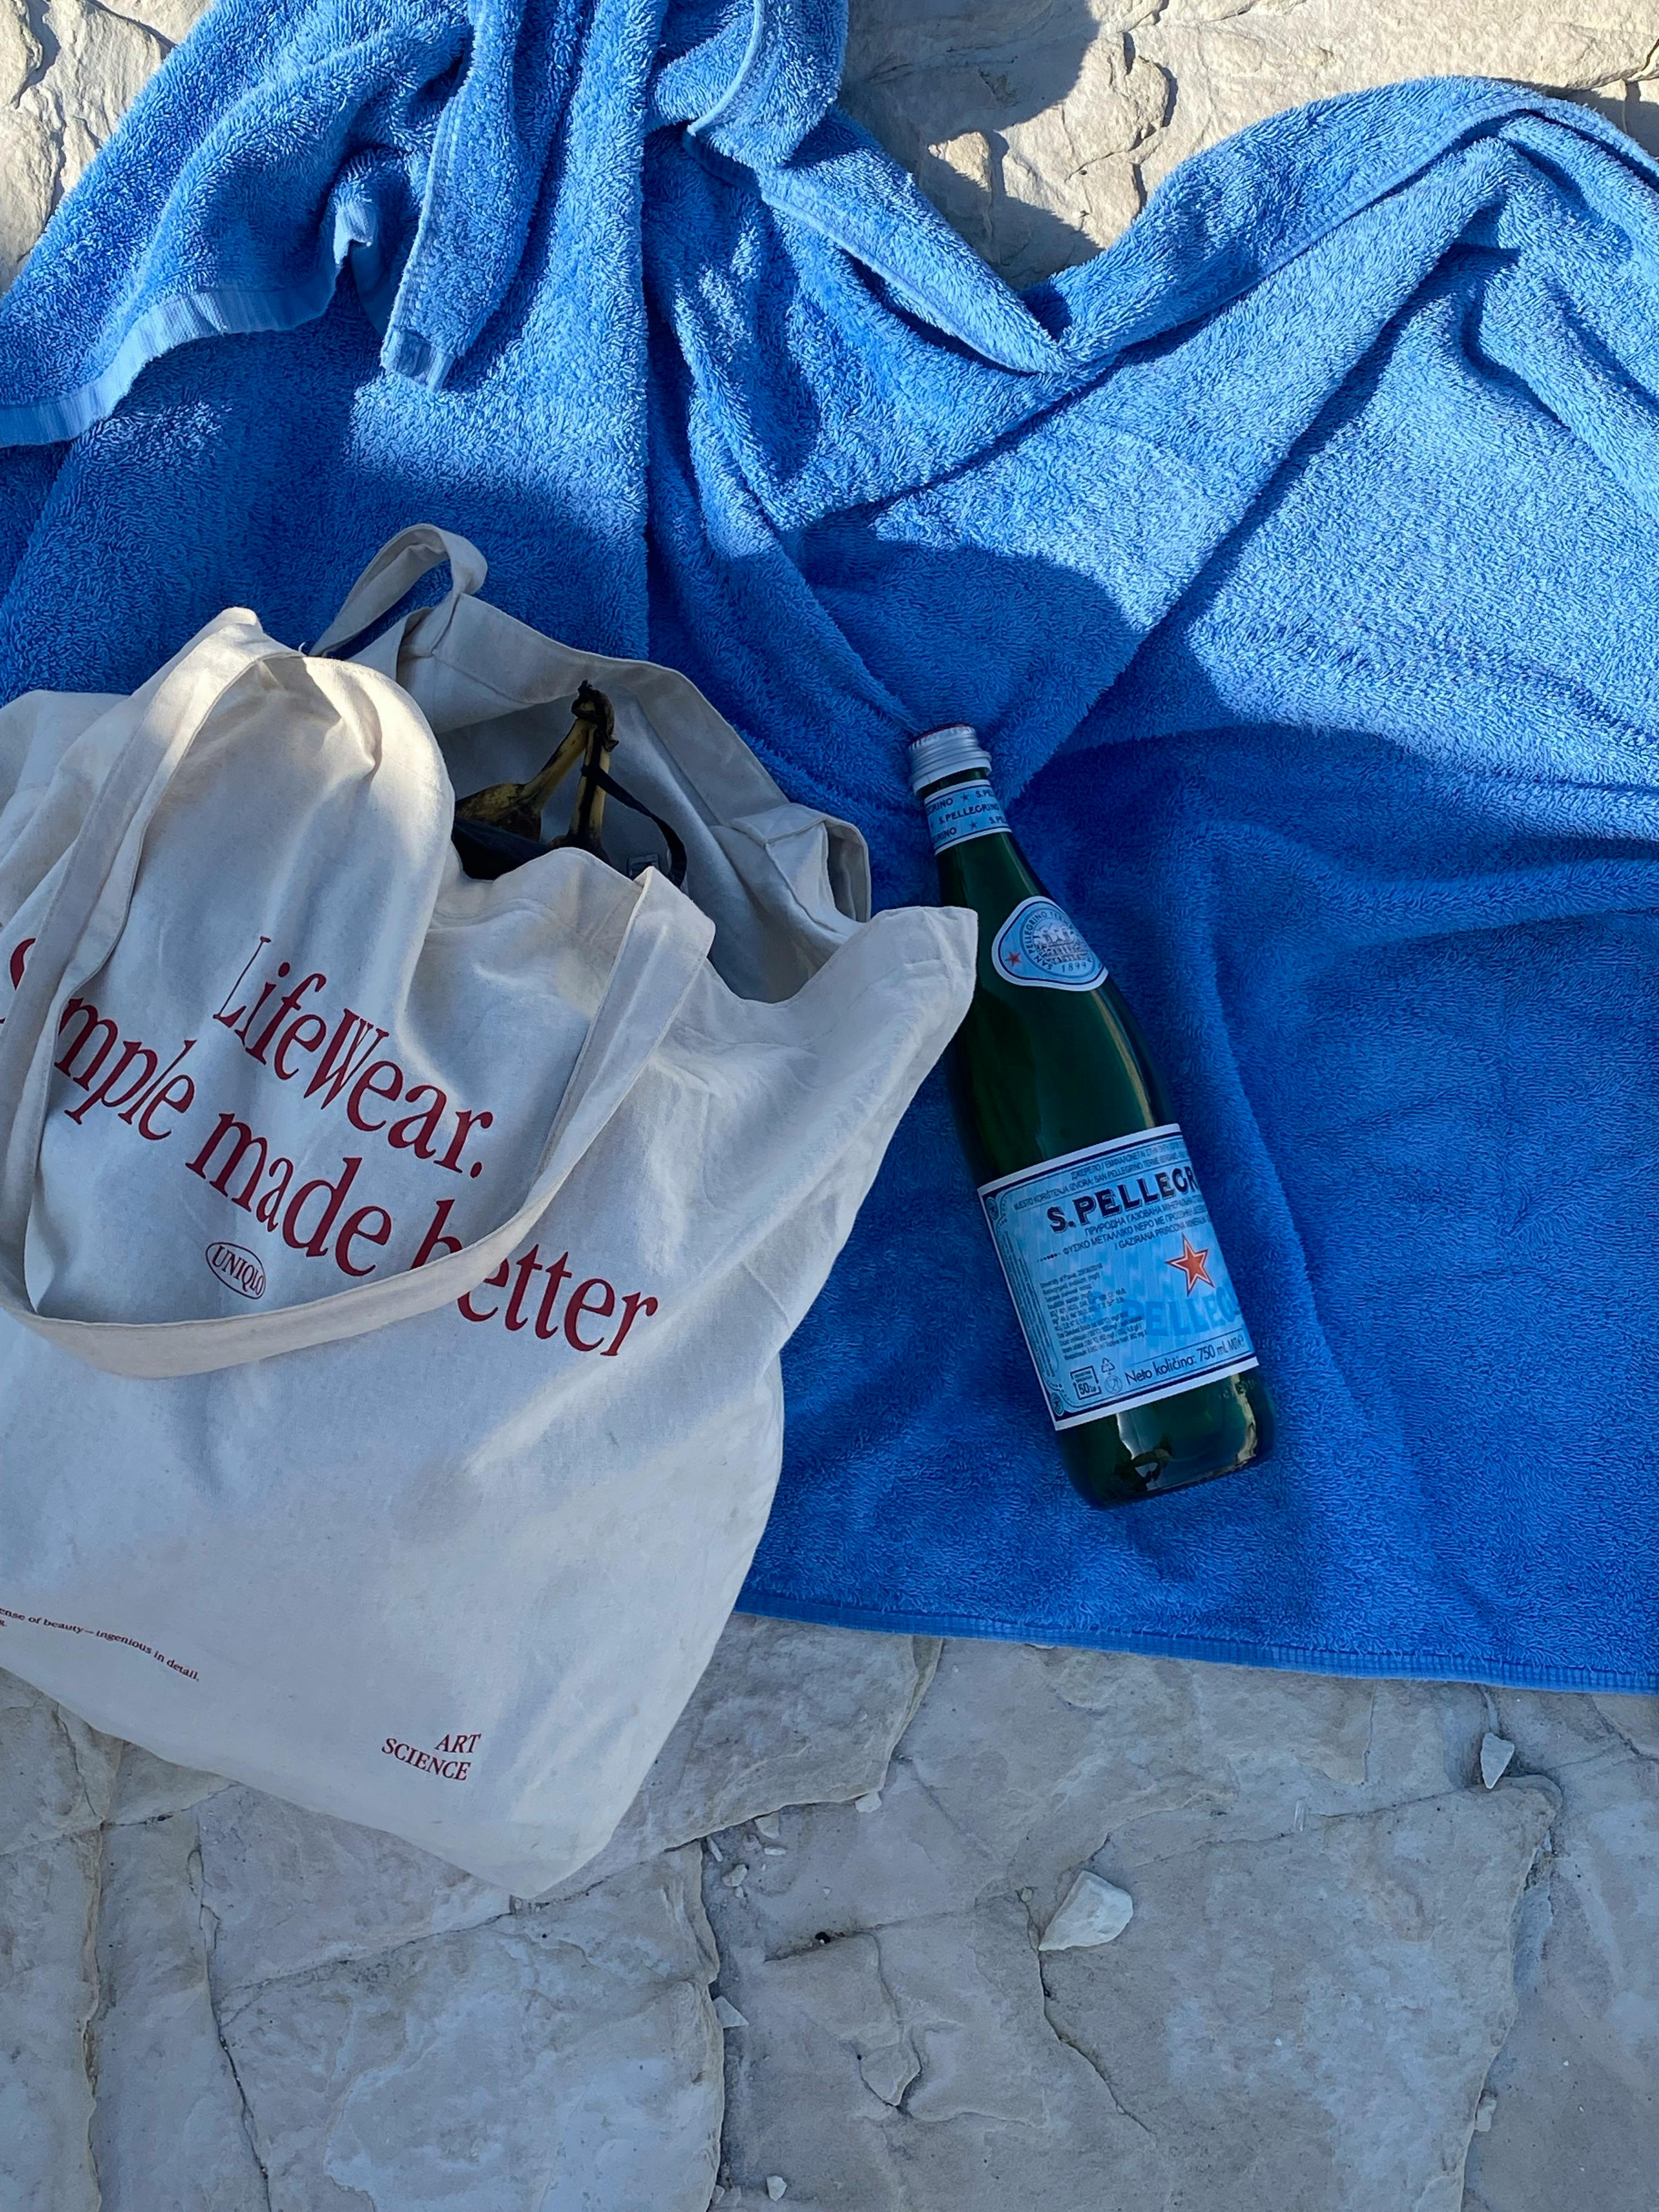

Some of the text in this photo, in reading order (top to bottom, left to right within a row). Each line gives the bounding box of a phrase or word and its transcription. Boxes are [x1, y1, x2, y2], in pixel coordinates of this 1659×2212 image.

[1024, 911, 1047, 954] PELLEGRINO
[1034, 955, 1053, 970] SAN
[1062, 962, 1086, 973] 1899
[213, 936, 493, 1178] LifeWear.
[0, 938, 196, 1141] mple
[185, 1113, 392, 1277] made
[1118, 1229, 1156, 1249] GAZIRANA
[212, 1245, 264, 1296] UNIQLO
[1125, 1369, 1153, 1385] Neto
[1153, 1355, 1197, 1376] količina:
[1197, 1344, 1216, 1362] 750
[1217, 1341, 1229, 1355] ml
[154, 1650, 165, 1662] in
[166, 1659, 200, 1681] detail.
[381, 1737, 471, 1781] SCIENCE
[434, 1733, 482, 1753] ART
